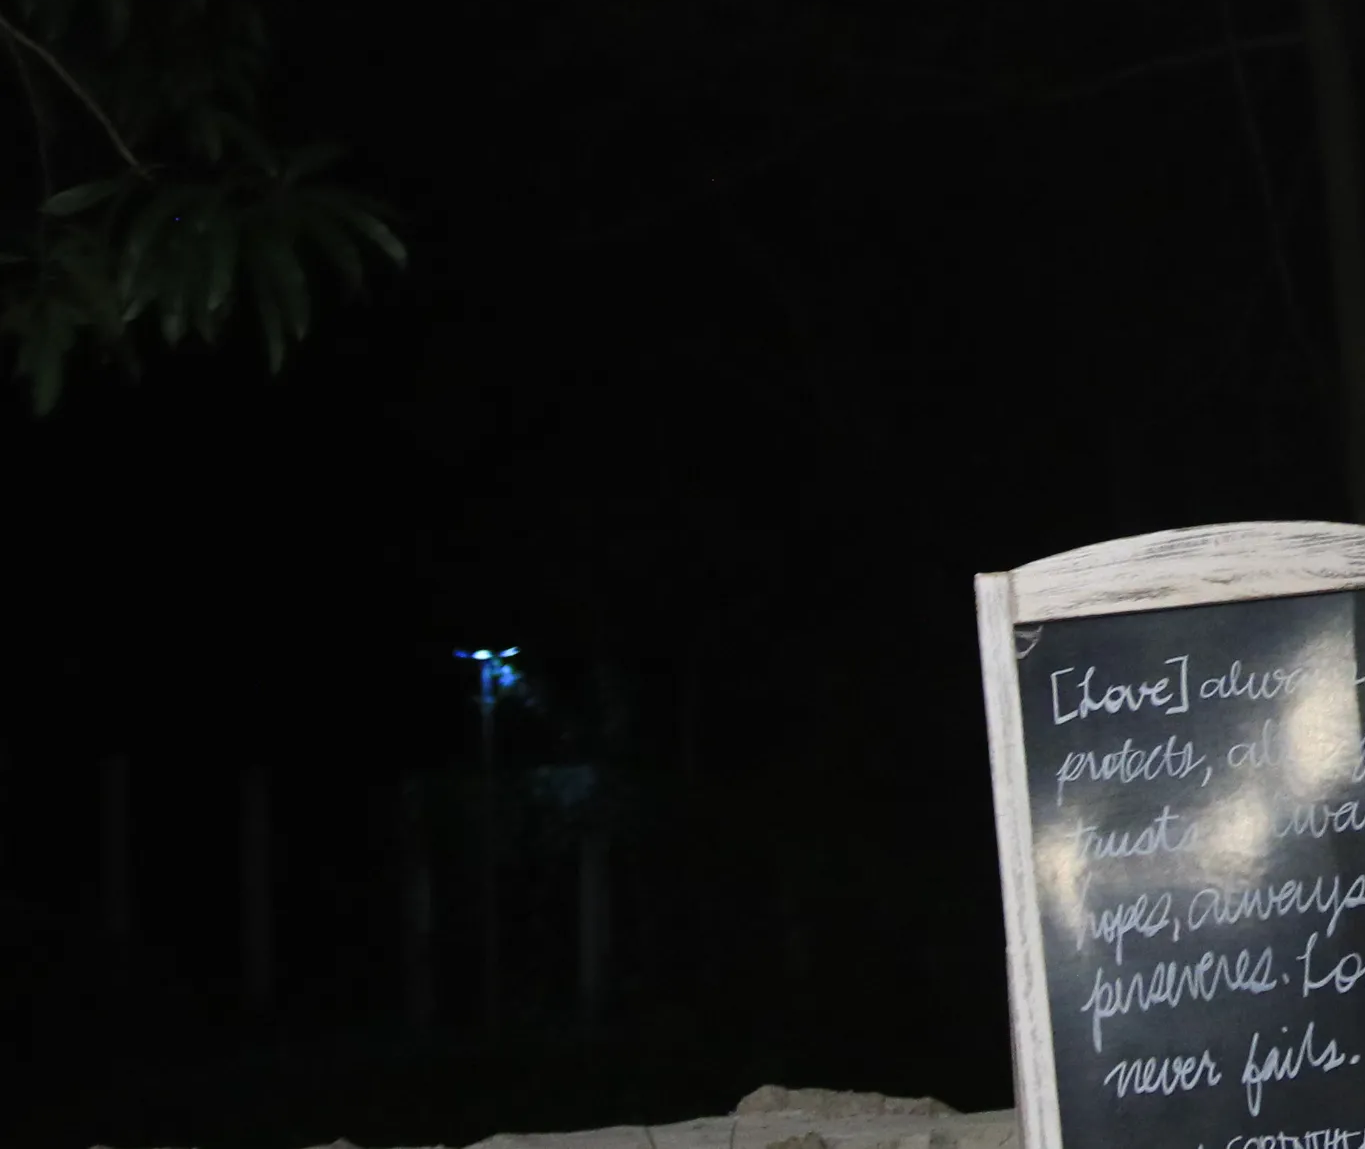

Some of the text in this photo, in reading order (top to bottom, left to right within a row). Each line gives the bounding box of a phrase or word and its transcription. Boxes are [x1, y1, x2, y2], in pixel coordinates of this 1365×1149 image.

[1050, 654, 1190, 725] [Love]
[1055, 734, 1214, 806] protects,
[1075, 872, 1180, 966] hopes,
[1104, 1021, 1361, 1117] never fails.
